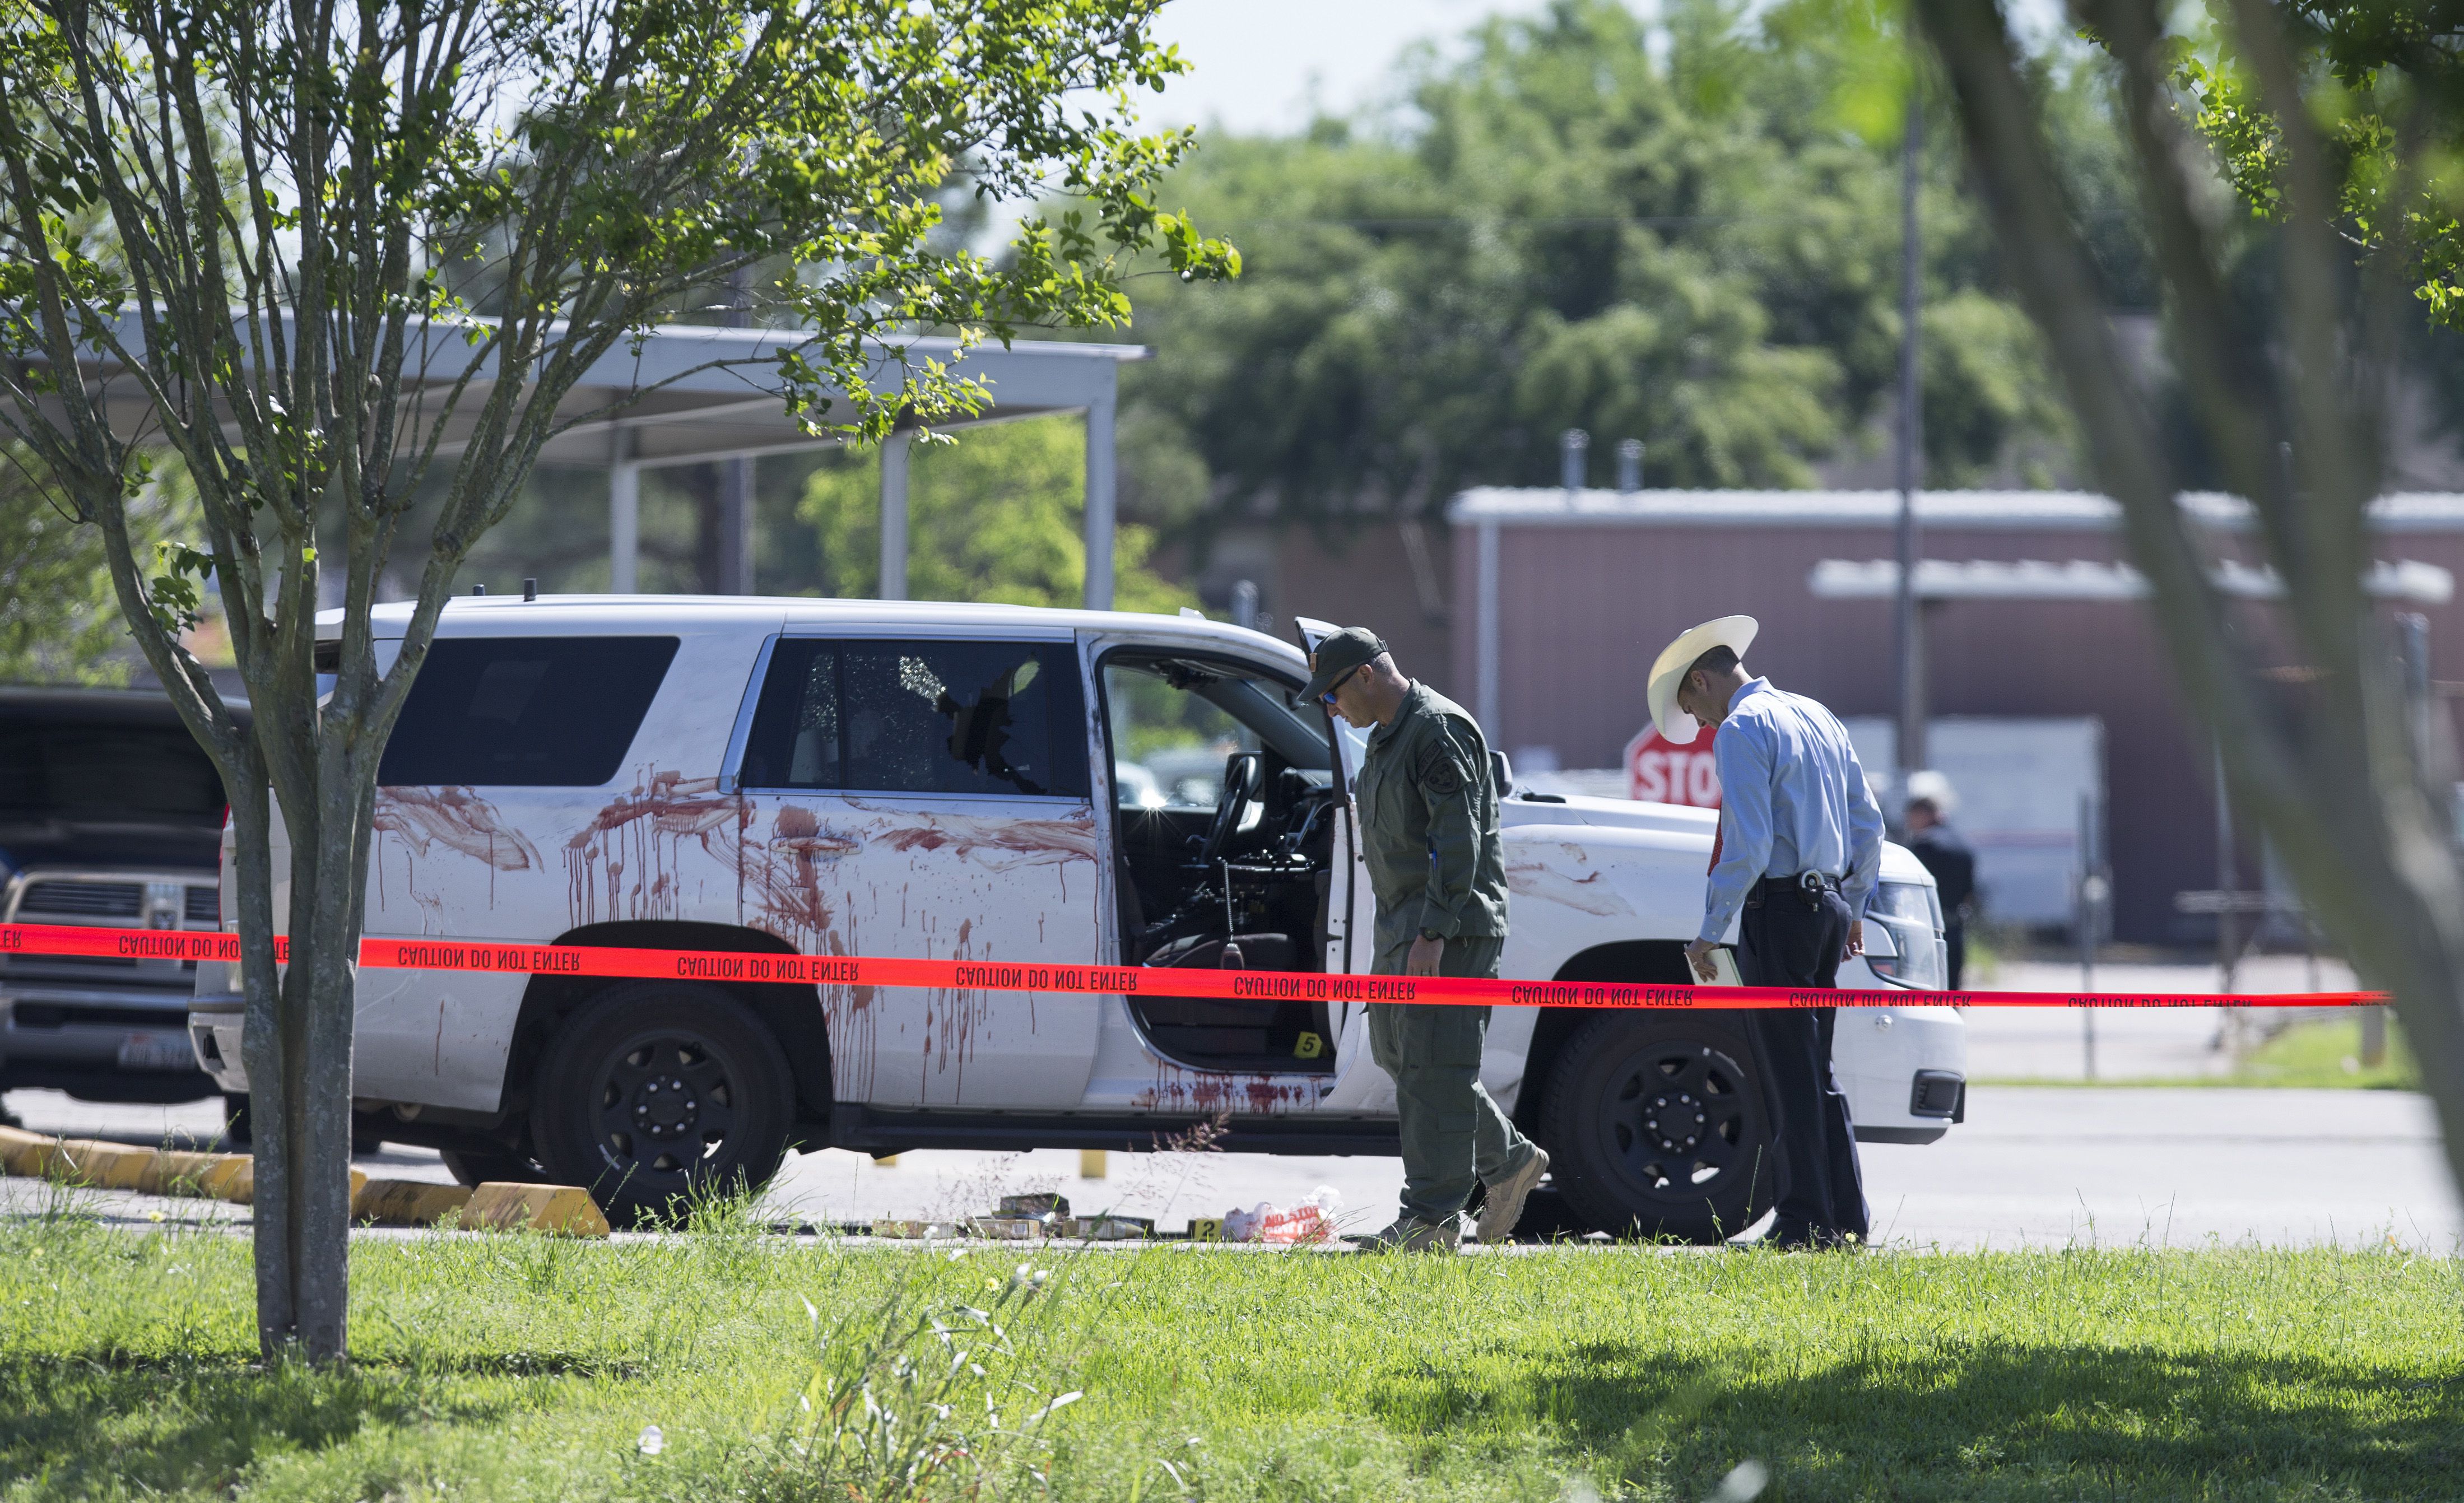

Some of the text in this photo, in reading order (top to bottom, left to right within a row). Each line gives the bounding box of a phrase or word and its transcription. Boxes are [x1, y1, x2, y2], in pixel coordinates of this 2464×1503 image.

[1638, 751, 1721, 806] STO
[1302, 1036, 1317, 1052] 5
[1203, 1220, 1215, 1236] 2
